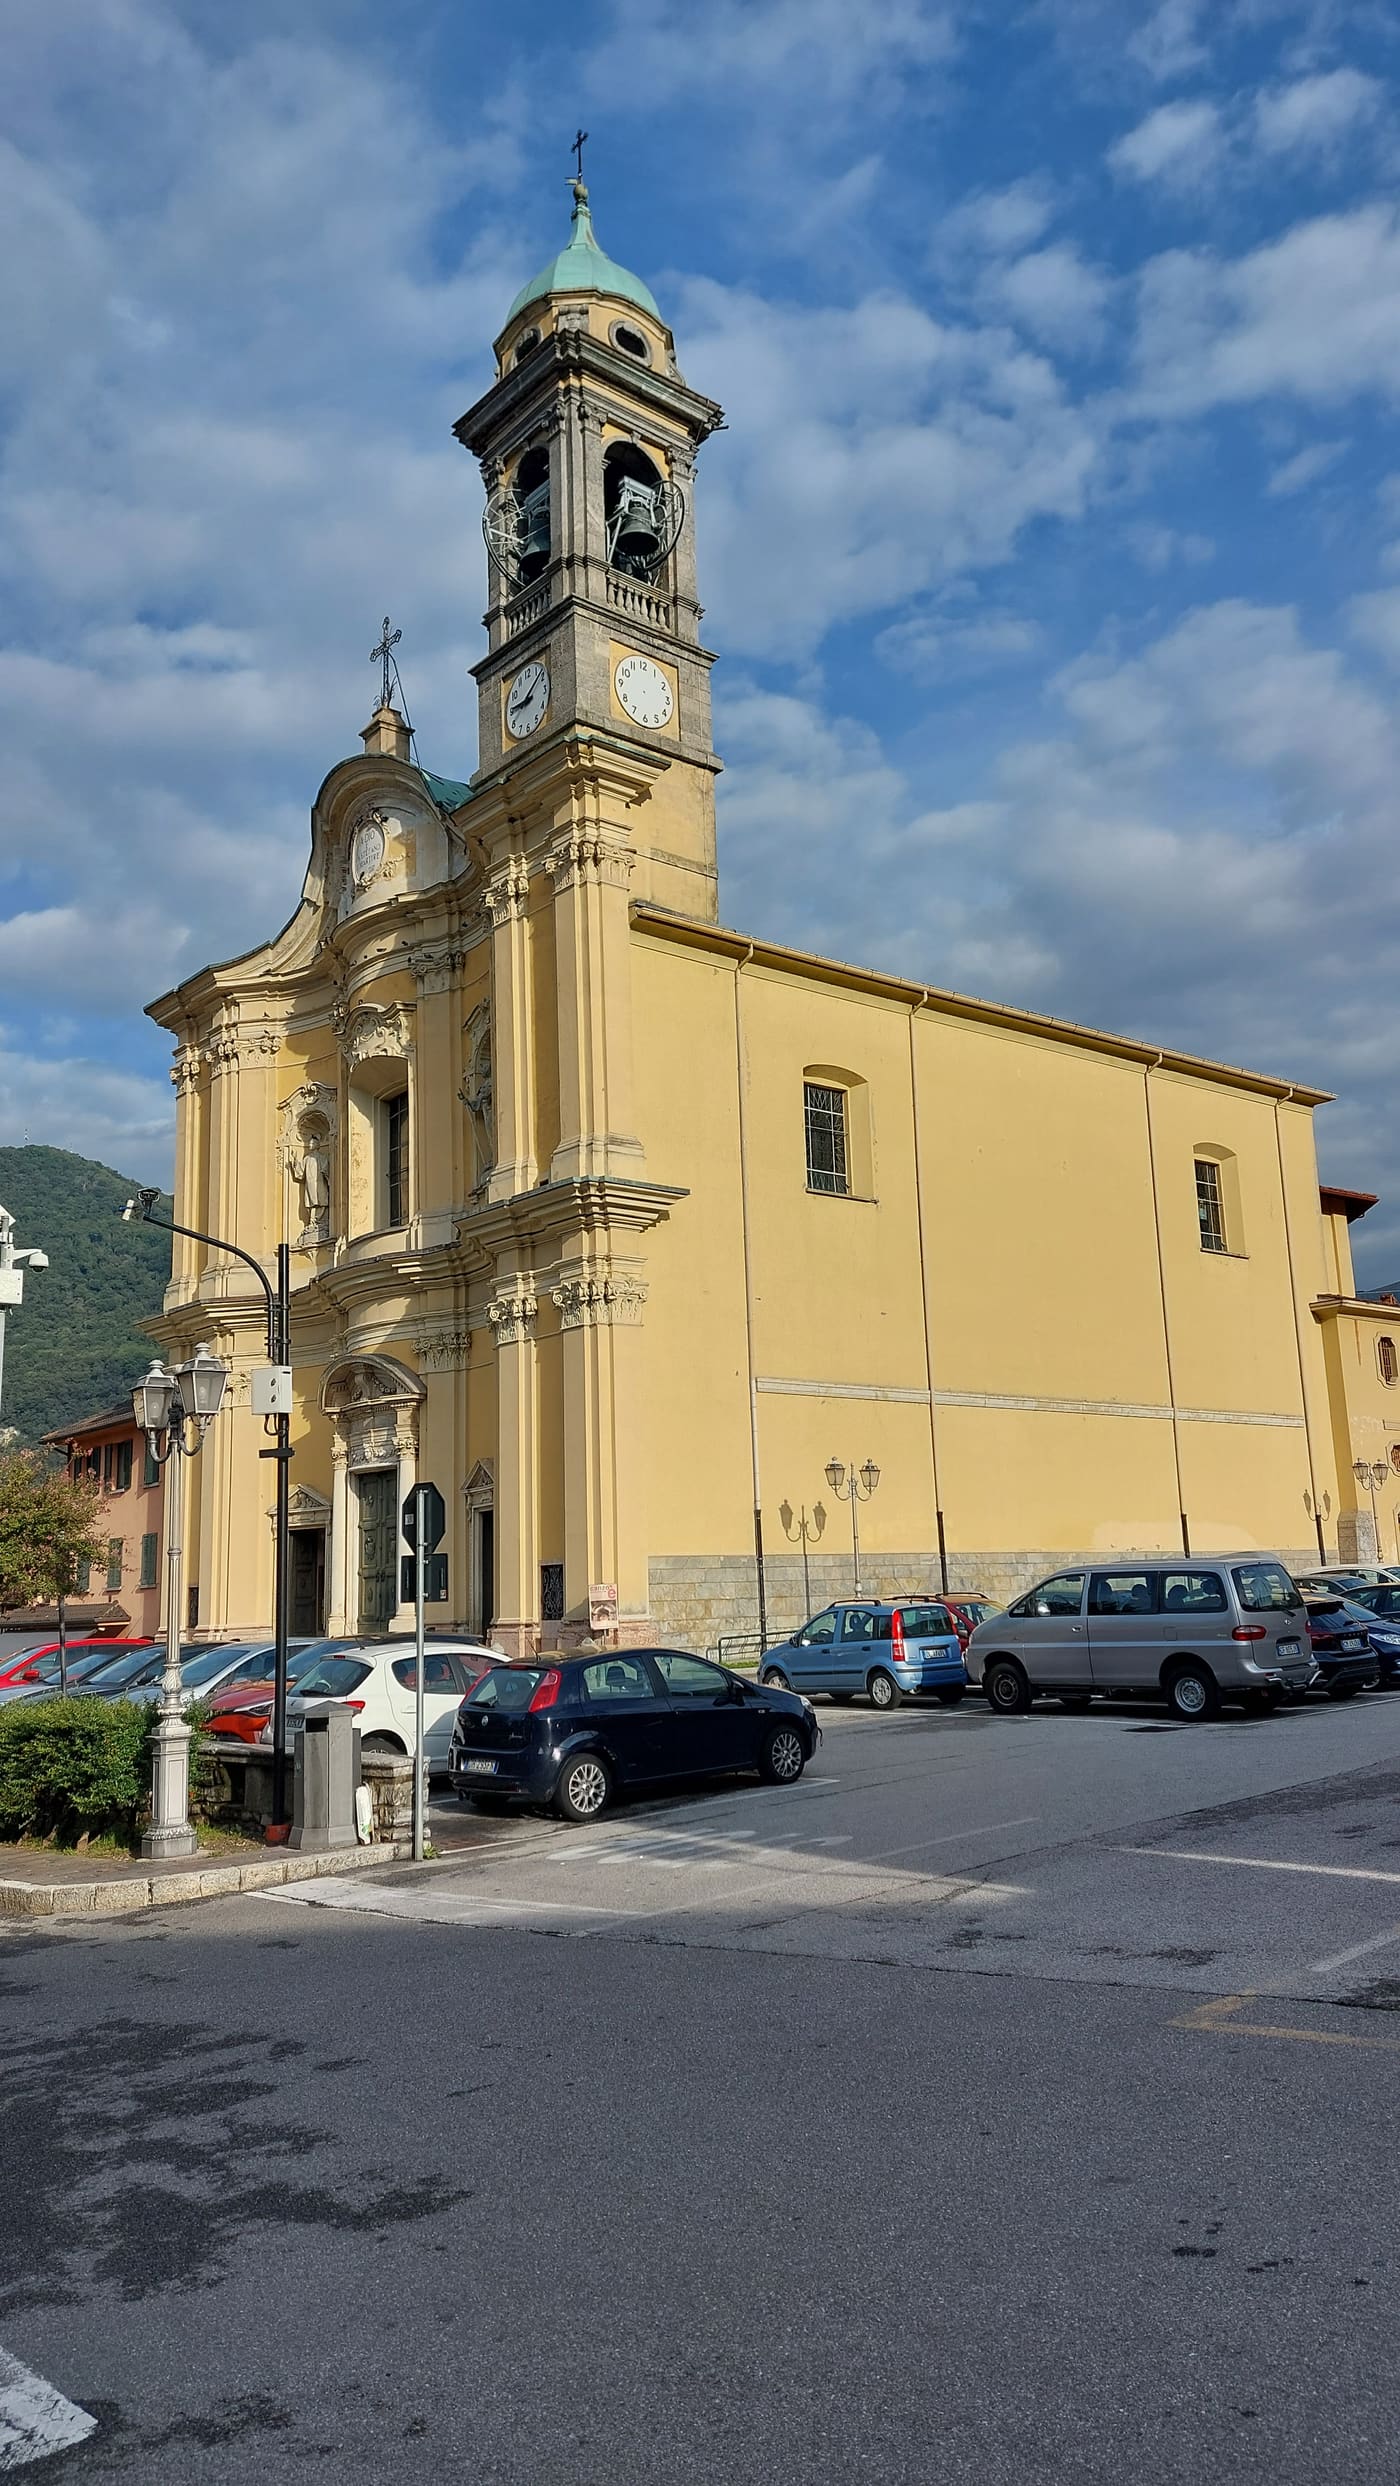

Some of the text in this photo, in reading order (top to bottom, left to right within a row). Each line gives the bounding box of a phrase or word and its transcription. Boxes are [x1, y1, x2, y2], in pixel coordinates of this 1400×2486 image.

[631, 660, 635, 671] 11
[640, 660, 647, 671] 12
[525, 668, 531, 680] 12
[622, 667, 630, 678] 10
[518, 677, 523, 688] 11
[618, 679, 623, 687] 9
[661, 681, 666, 691] 2
[543, 685, 547, 694] 3
[512, 690, 518, 701] 10
[623, 693, 628, 702] 8
[665, 696, 670, 705] 3
[541, 700, 544, 709] 4
[632, 705, 637, 714] 7
[662, 709, 667, 717] 4
[535, 714, 538, 724] 5
[643, 714, 648, 723] 6
[654, 714, 659, 723] 5
[518, 724, 523, 735] 7
[526, 723, 531, 733] 6
